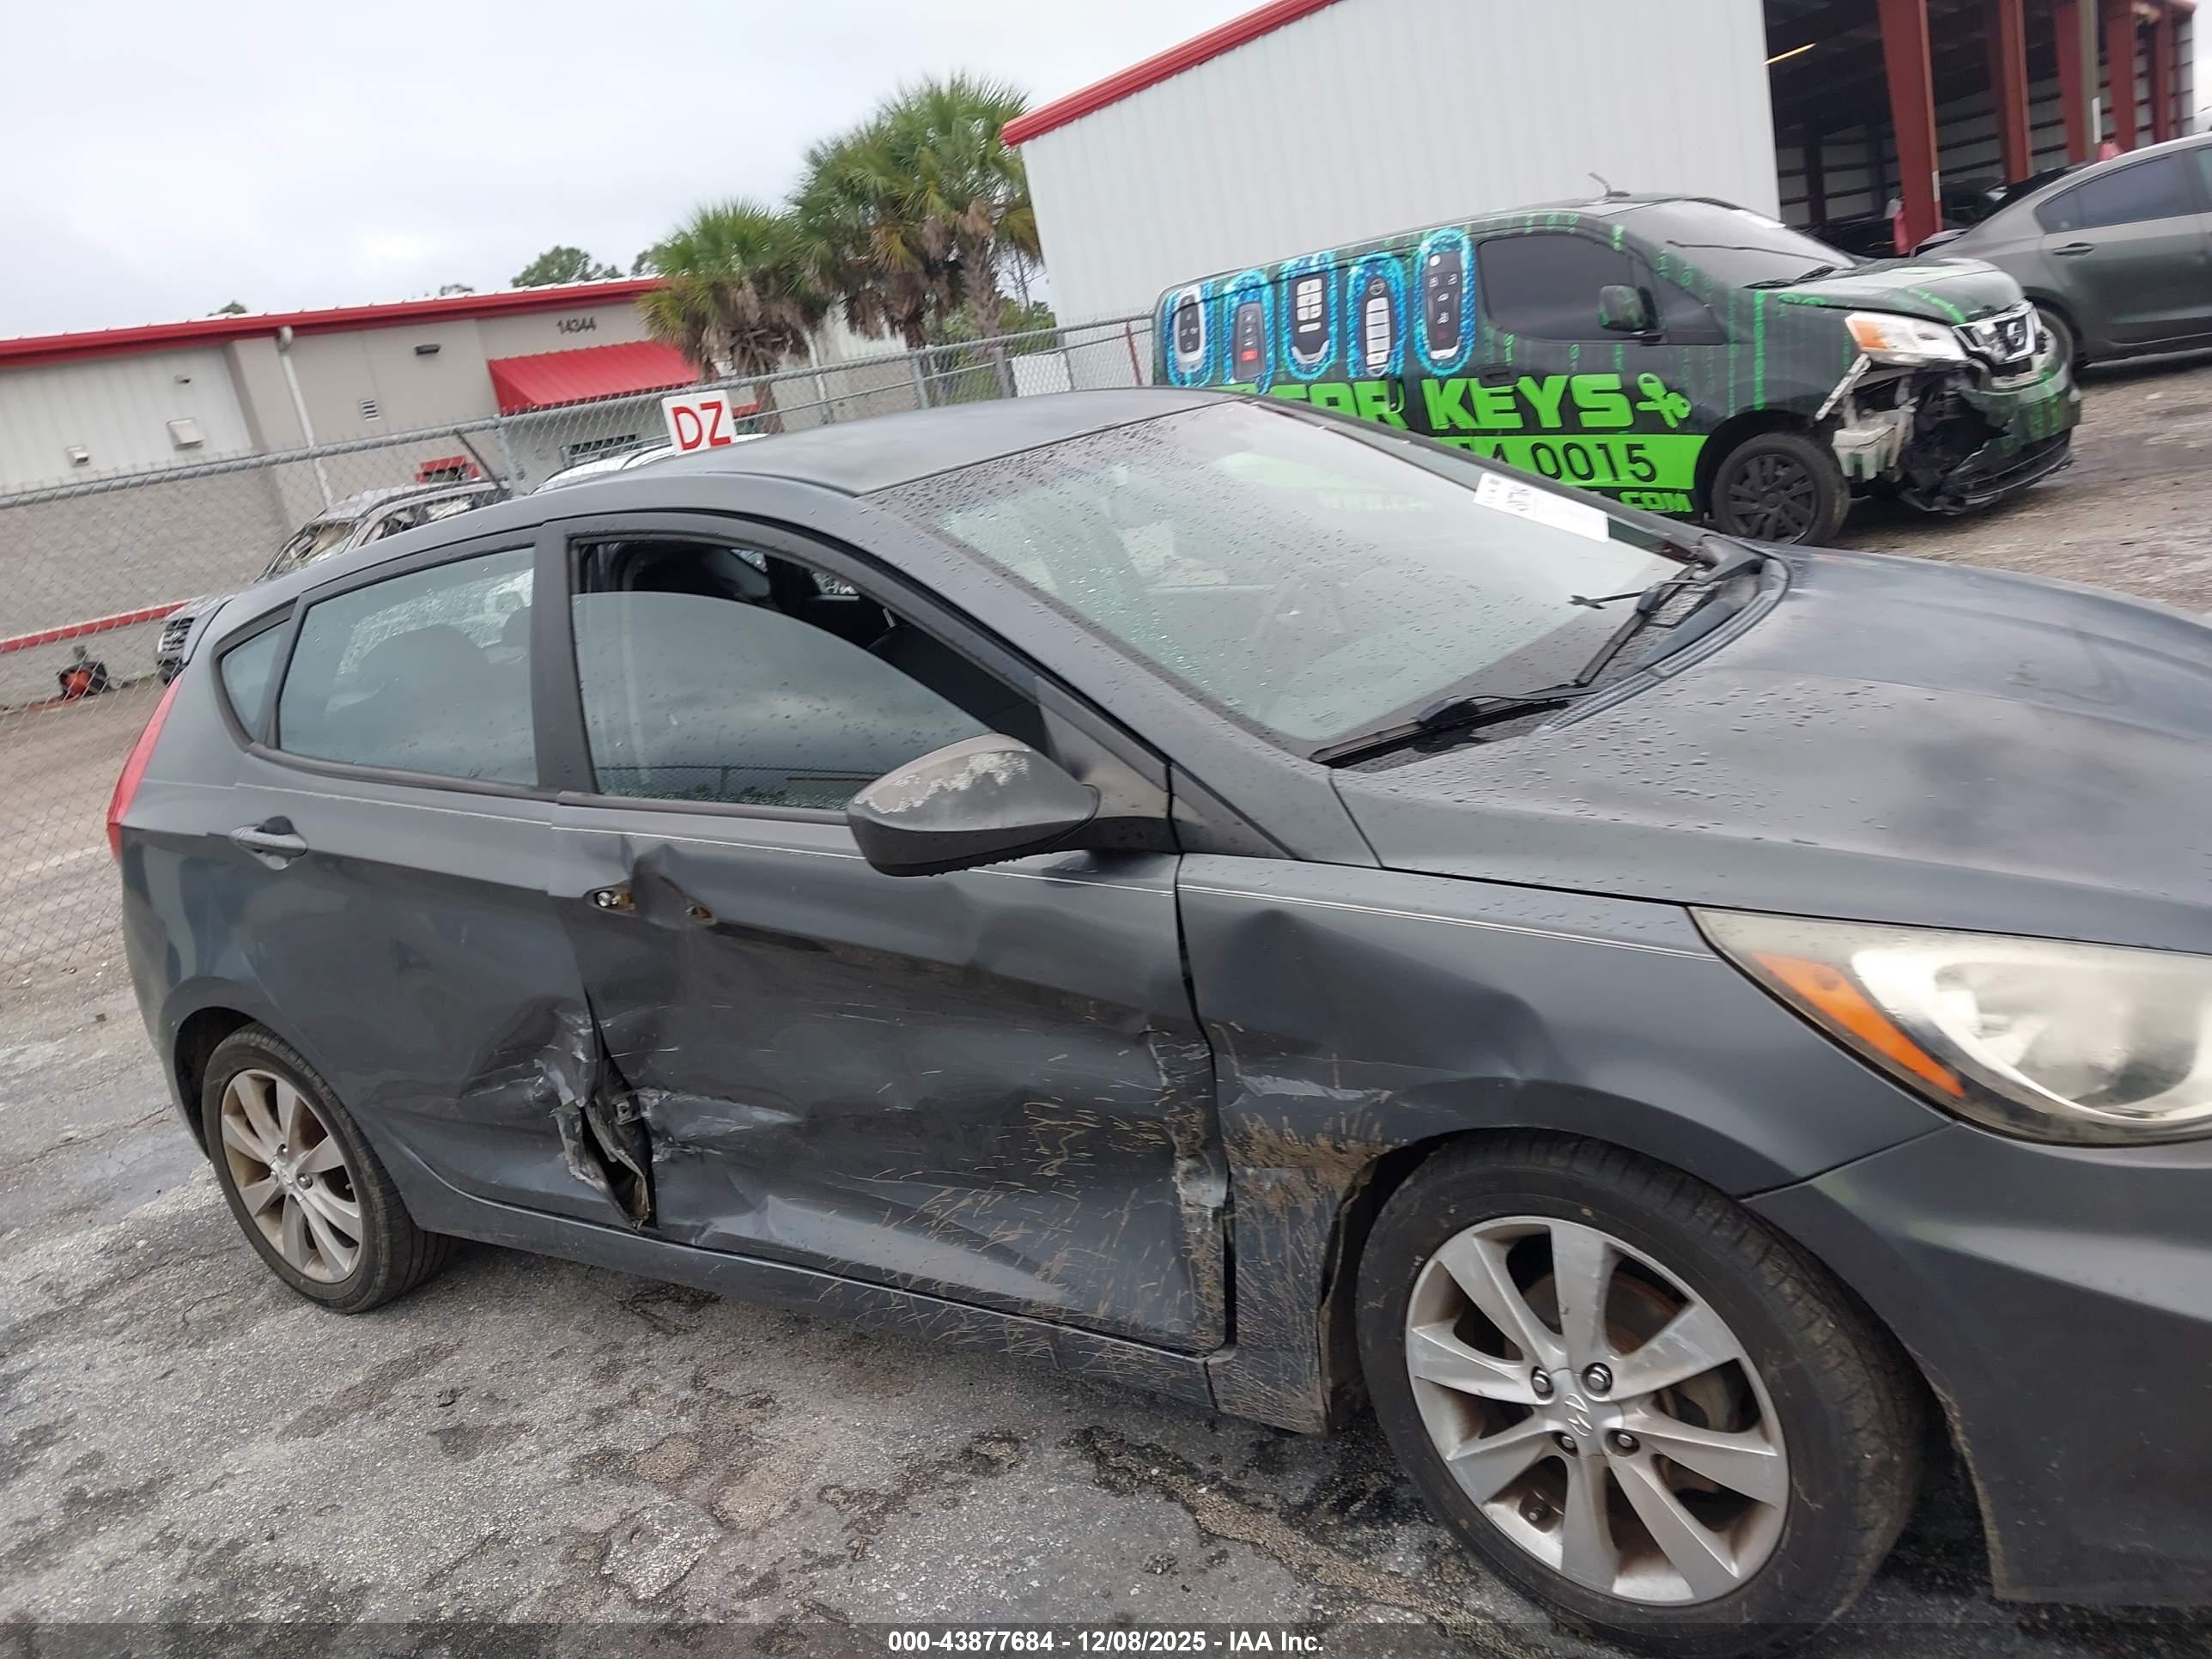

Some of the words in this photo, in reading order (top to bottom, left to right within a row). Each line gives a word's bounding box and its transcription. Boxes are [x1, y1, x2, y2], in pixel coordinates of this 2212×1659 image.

[556, 316, 598, 335] 14344
[1269, 380, 1410, 430] AR
[1421, 373, 1634, 429] KEYS
[672, 400, 732, 451] DZ
[1530, 441, 1656, 483] 0015
